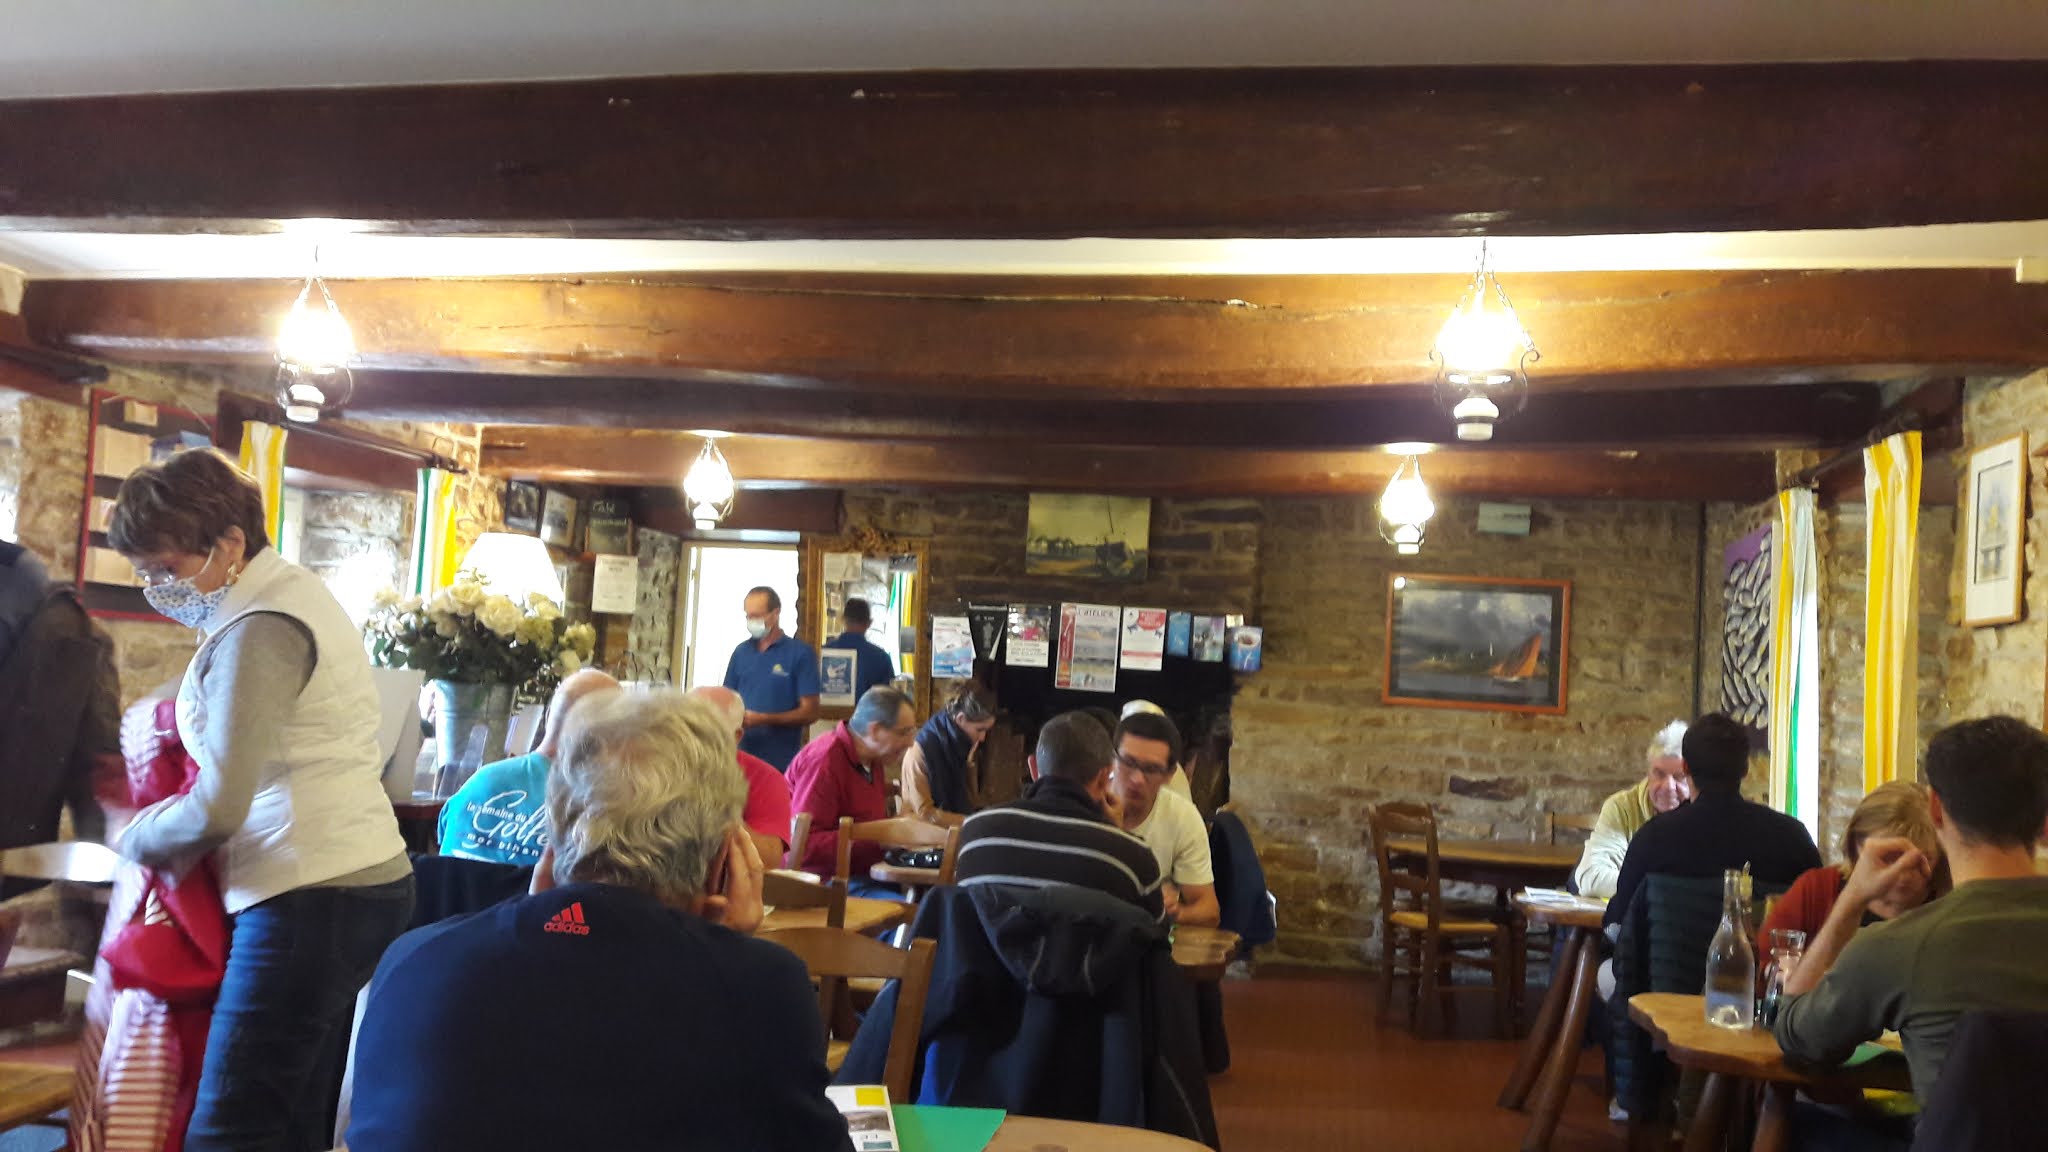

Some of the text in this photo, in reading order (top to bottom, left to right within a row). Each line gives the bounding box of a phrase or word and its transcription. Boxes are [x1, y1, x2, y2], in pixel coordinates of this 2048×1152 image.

[473, 790, 549, 846] Golfe
[477, 805, 514, 819] semaine
[515, 812, 527, 822] du
[544, 922, 590, 936] adidas
